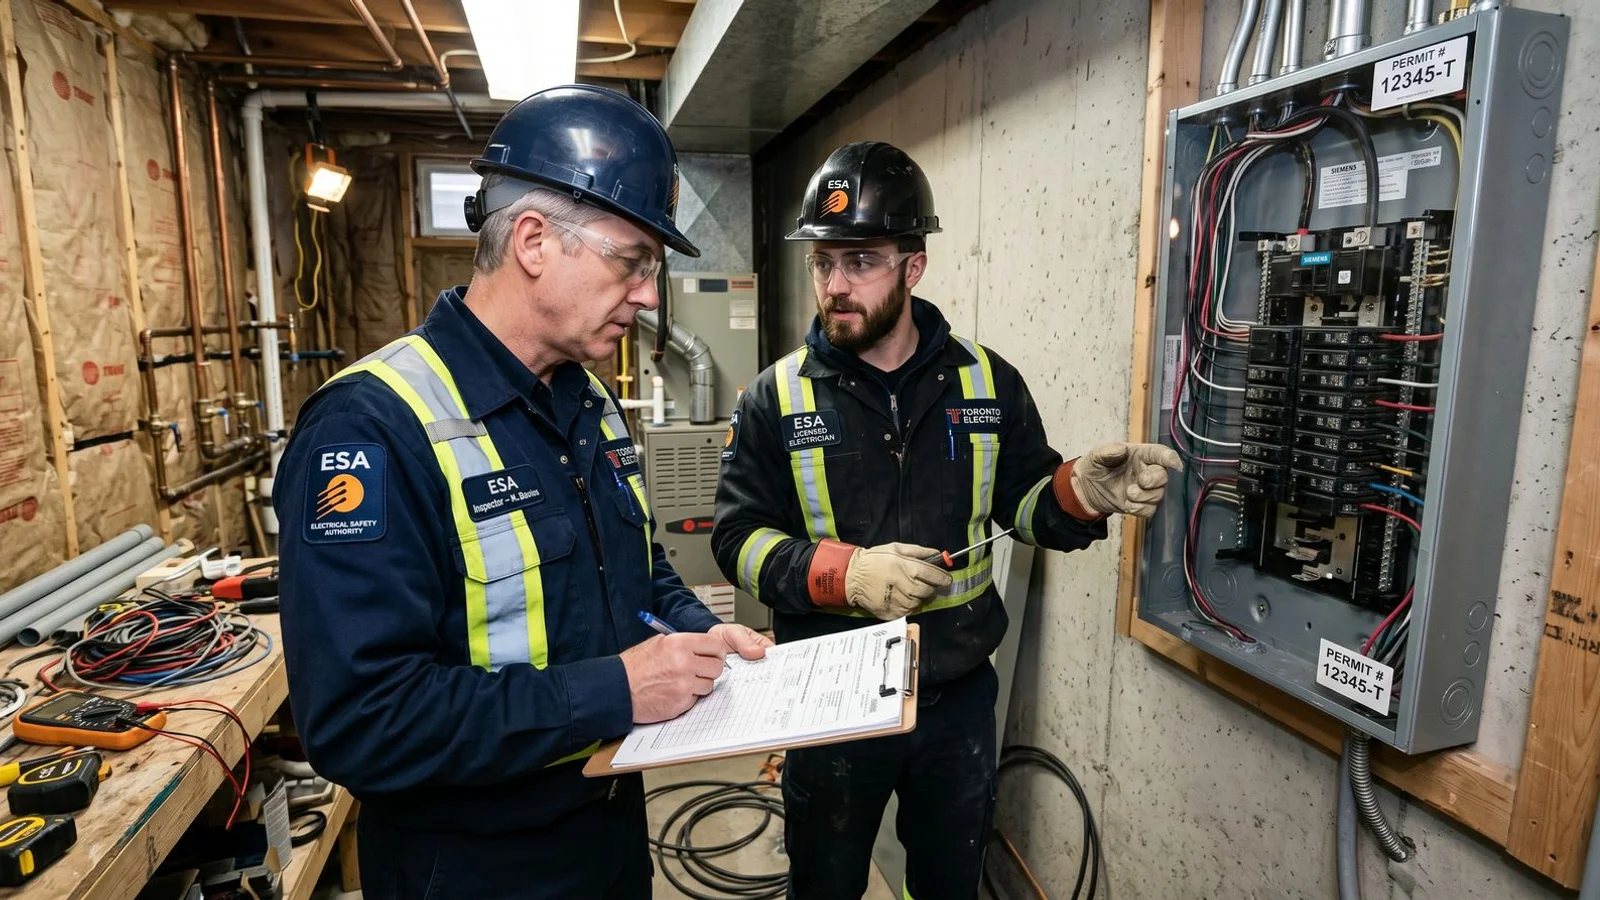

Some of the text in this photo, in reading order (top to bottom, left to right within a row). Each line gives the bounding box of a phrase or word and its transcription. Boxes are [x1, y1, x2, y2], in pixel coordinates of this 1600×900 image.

[1392, 47, 1446, 71] PERMIT #
[1381, 59, 1456, 93] 12345-T
[1331, 164, 1357, 174] SIEMENS
[828, 180, 849, 189] ESA
[1303, 255, 1328, 264] SIEMENS
[961, 408, 1001, 416] TORONTO
[794, 415, 825, 429] ESA
[963, 416, 1001, 424] ELECTRIC
[793, 427, 828, 438] LICENSED
[788, 434, 835, 447] ELECTRICIAN
[320, 451, 371, 472] ESA
[487, 475, 519, 495] ESA
[472, 498, 504, 513] Inspector
[310, 520, 377, 530] ELECTRICAL SAFETY
[324, 528, 364, 536] AUTHORITY
[1326, 647, 1384, 681] PERMIT #
[1323, 663, 1385, 700] 12345-T
